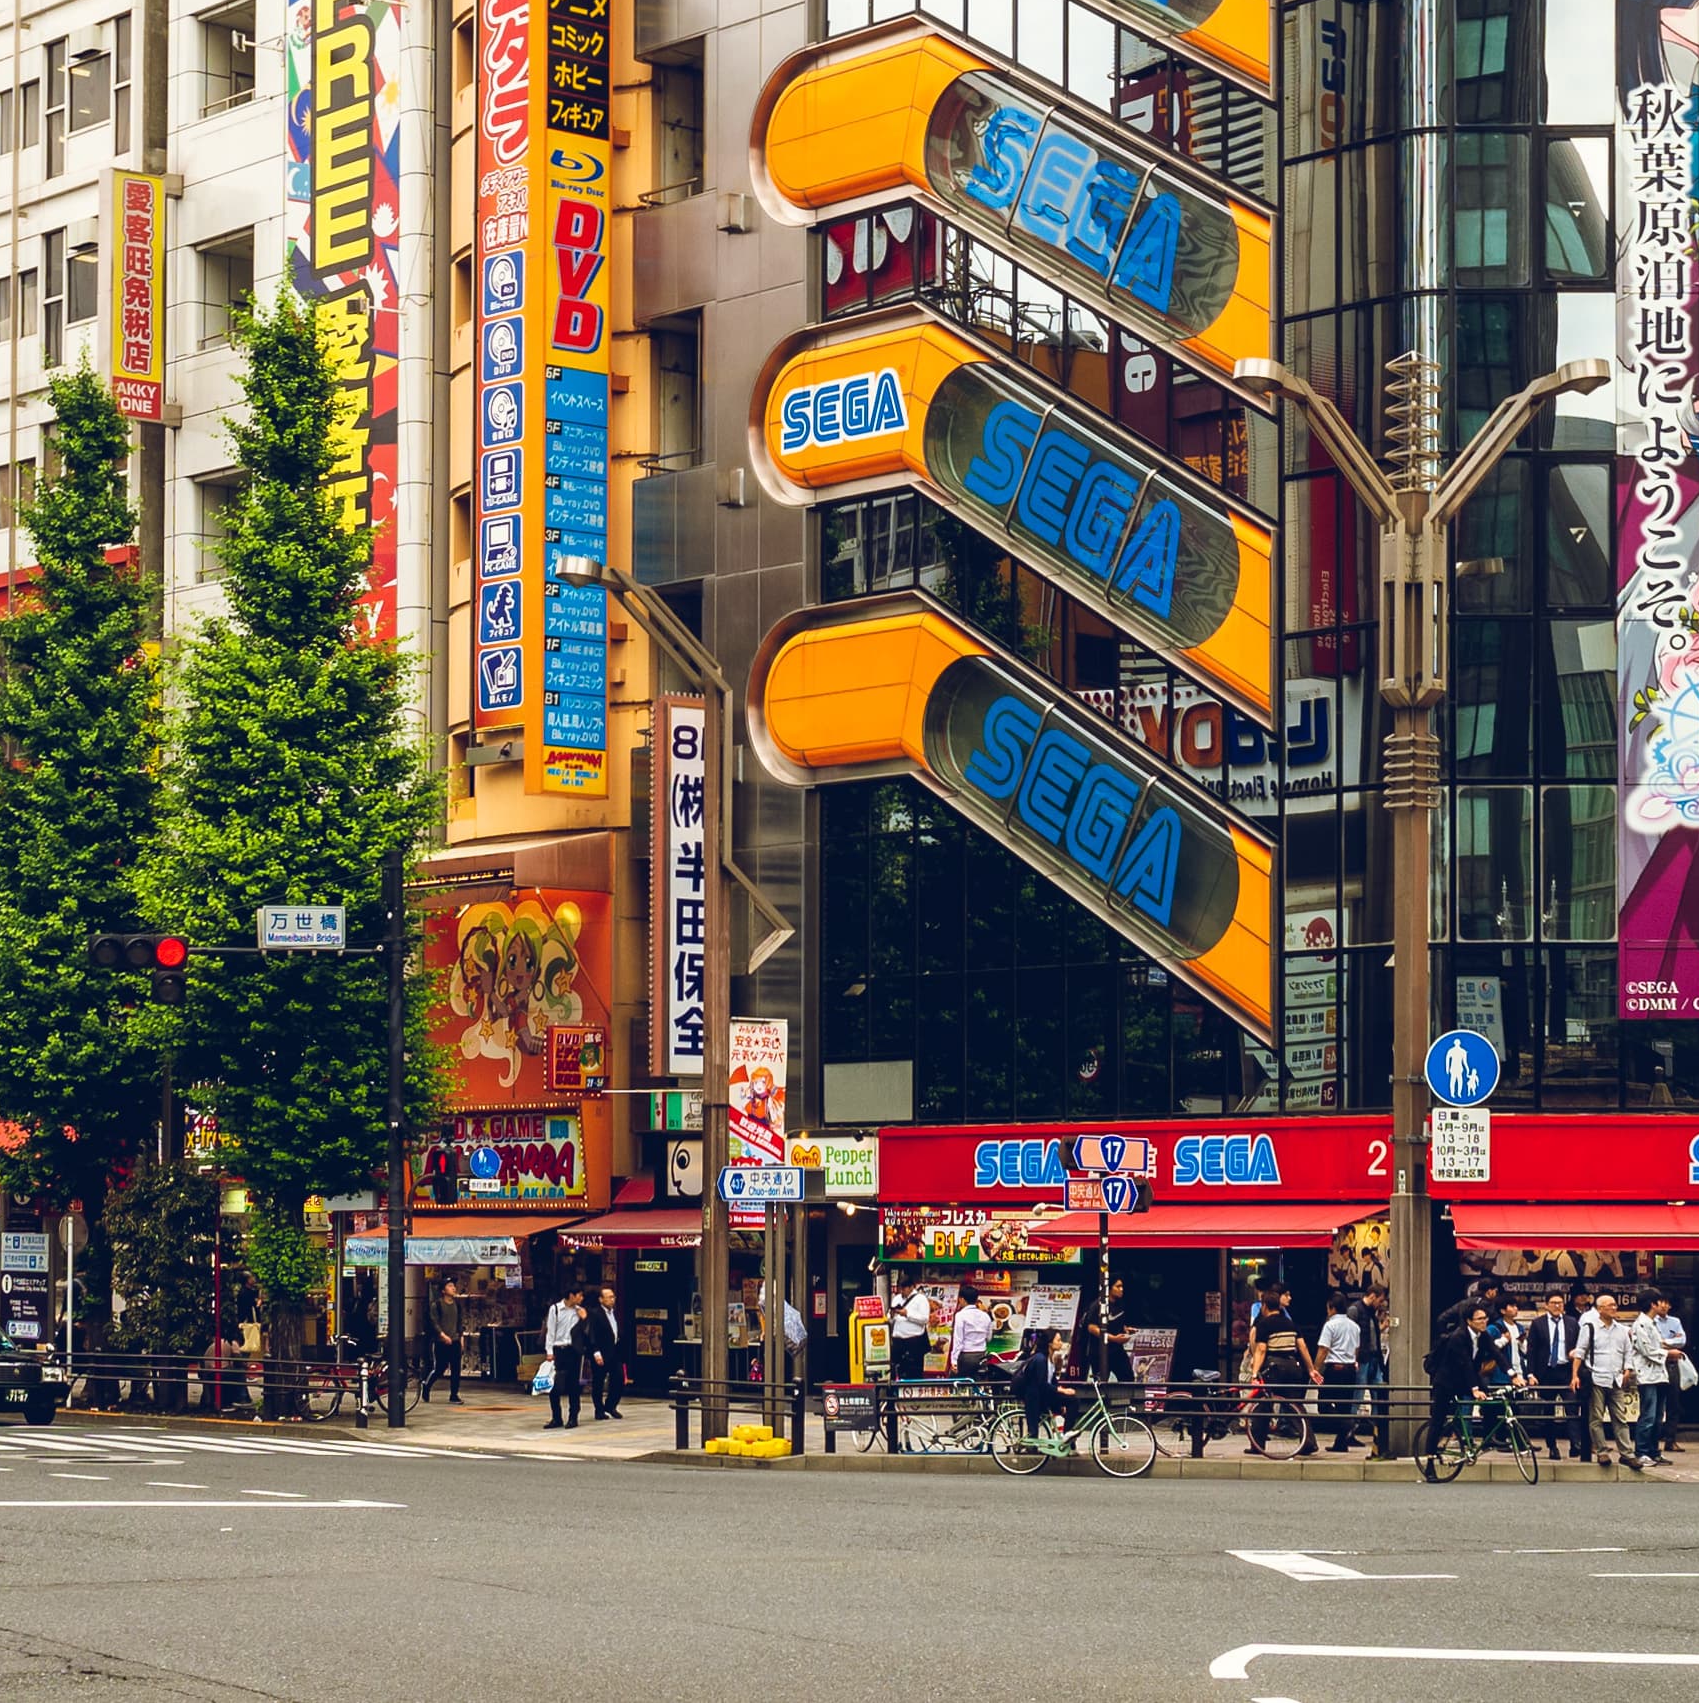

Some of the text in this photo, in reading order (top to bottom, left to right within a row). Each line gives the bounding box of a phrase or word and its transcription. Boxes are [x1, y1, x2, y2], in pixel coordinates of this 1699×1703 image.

[552, 25, 604, 56] コミック
[555, 61, 602, 91] ホビー
[552, 100, 604, 131] フィギュア
[967, 106, 1181, 315] SEGA
[552, 197, 604, 353] DVD
[546, 368, 561, 379] 6F
[1632, 88, 1689, 654] 秋葉原泊地にようこそ。
[117, 383, 157, 397] AKKY
[120, 399, 153, 414] ONE
[783, 370, 906, 451] SEGA
[546, 422, 561, 433] 5F
[545, 476, 560, 487] 4F
[965, 400, 1182, 620] SEGA
[545, 530, 560, 542] 3F
[545, 584, 559, 596] 2F
[545, 638, 560, 650] 1F
[545, 693, 559, 705] B1
[965, 696, 1179, 926] SEGA
[271, 913, 338, 931] 万世橋
[268, 933, 340, 945] Manseibashi Bridge
[826, 1146, 873, 1165] Pepper
[1105, 1142, 1122, 1162] 17
[1172, 1133, 1281, 1186] SEGA
[975, 1139, 1068, 1187] SEGA
[731, 1179, 744, 1189] 437
[750, 1172, 793, 1186] 中央通り
[825, 1168, 873, 1186] Lunch
[1107, 1183, 1123, 1203] 17
[941, 1210, 987, 1225] フレスカ
[934, 1232, 955, 1257] B1
